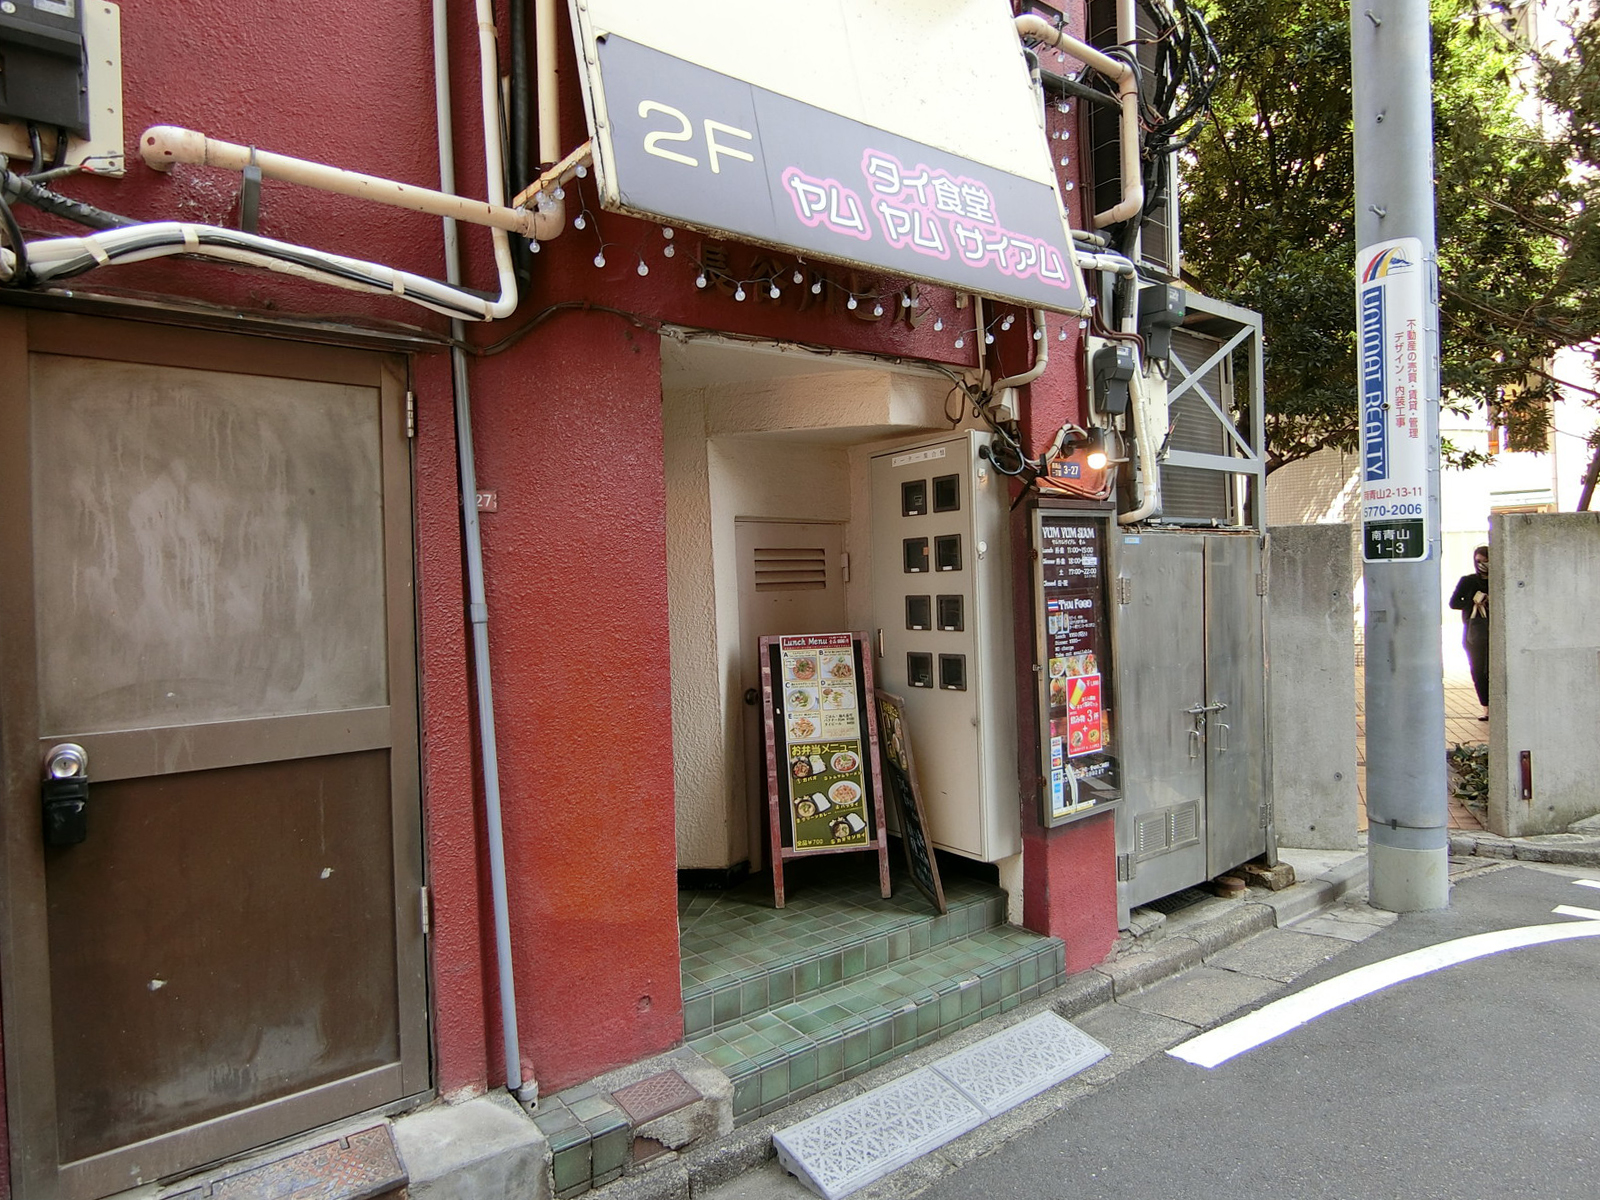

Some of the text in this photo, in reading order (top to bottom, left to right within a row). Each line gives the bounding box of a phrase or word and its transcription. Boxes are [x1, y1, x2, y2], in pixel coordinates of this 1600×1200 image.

[637, 99, 754, 174] 2F
[868, 154, 995, 225] タイ食堂
[789, 175, 1066, 282] ヤム ヤム サイアム
[1363, 290, 1383, 476] UNIMAT REALTY
[1394, 332, 1406, 428] デザイン・内装工事
[1406, 319, 1419, 439] 不動産の売買・賃貸・管理
[1063, 465, 1079, 476] 3-27
[1042, 527, 1095, 538] YUM YUM SIAM
[1371, 529, 1410, 541] 南青山
[1376, 542, 1405, 554] 1-3
[783, 638, 806, 646] Lunch
[808, 637, 828, 645] Menu
[791, 744, 858, 755] お弁当メニュー
